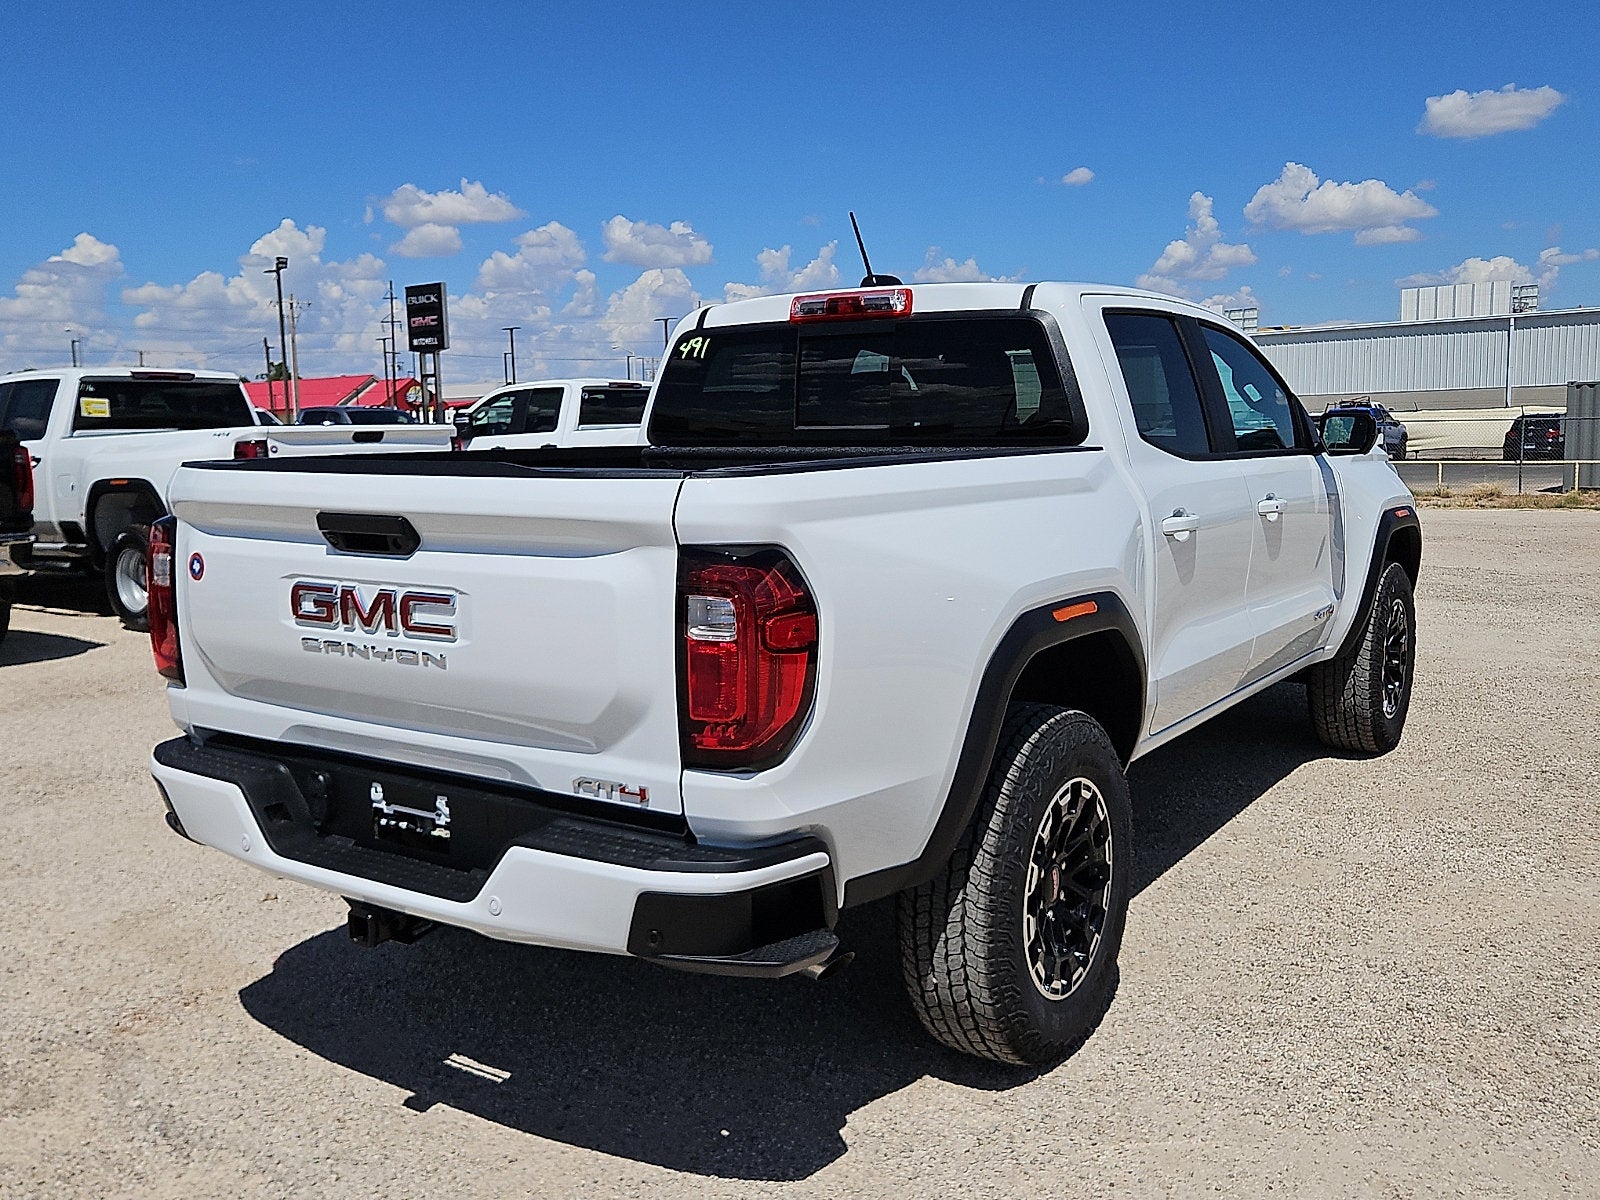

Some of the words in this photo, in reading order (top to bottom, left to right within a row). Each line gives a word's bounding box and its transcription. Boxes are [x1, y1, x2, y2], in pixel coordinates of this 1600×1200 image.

[407, 294, 438, 305] BUICK
[410, 315, 438, 327] GMC
[680, 336, 711, 359] 491
[290, 581, 457, 643] GMC
[300, 637, 448, 670] CANYON
[572, 777, 650, 808] AT4
